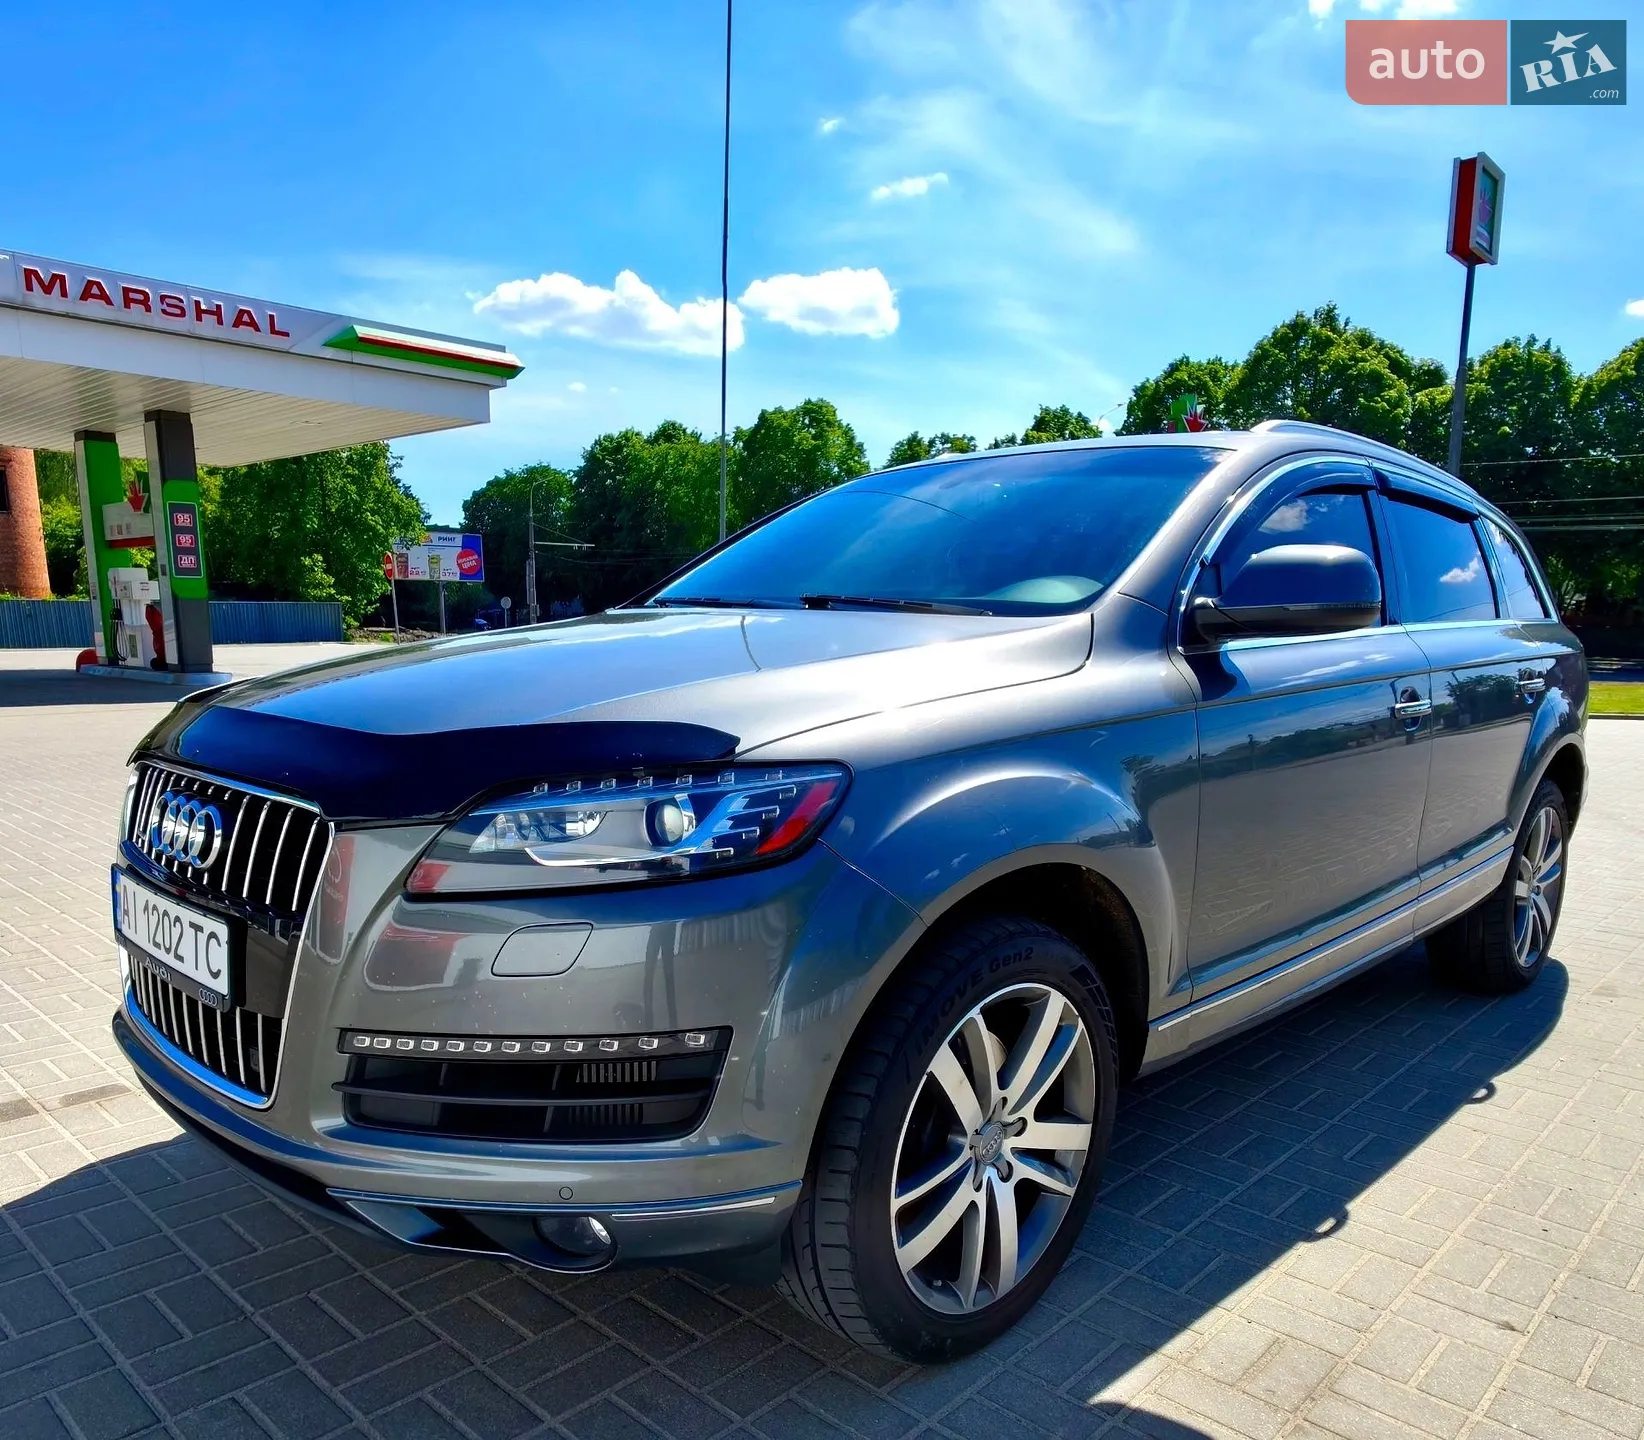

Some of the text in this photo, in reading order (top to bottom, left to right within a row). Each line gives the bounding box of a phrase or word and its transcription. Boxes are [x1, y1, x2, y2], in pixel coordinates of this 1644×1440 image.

[22, 266, 291, 338] MARSHAL
[143, 899, 185, 964] 1202
[188, 920, 222, 980] TC
[988, 946, 1035, 974] Gen2
[144, 956, 172, 982] Audi
